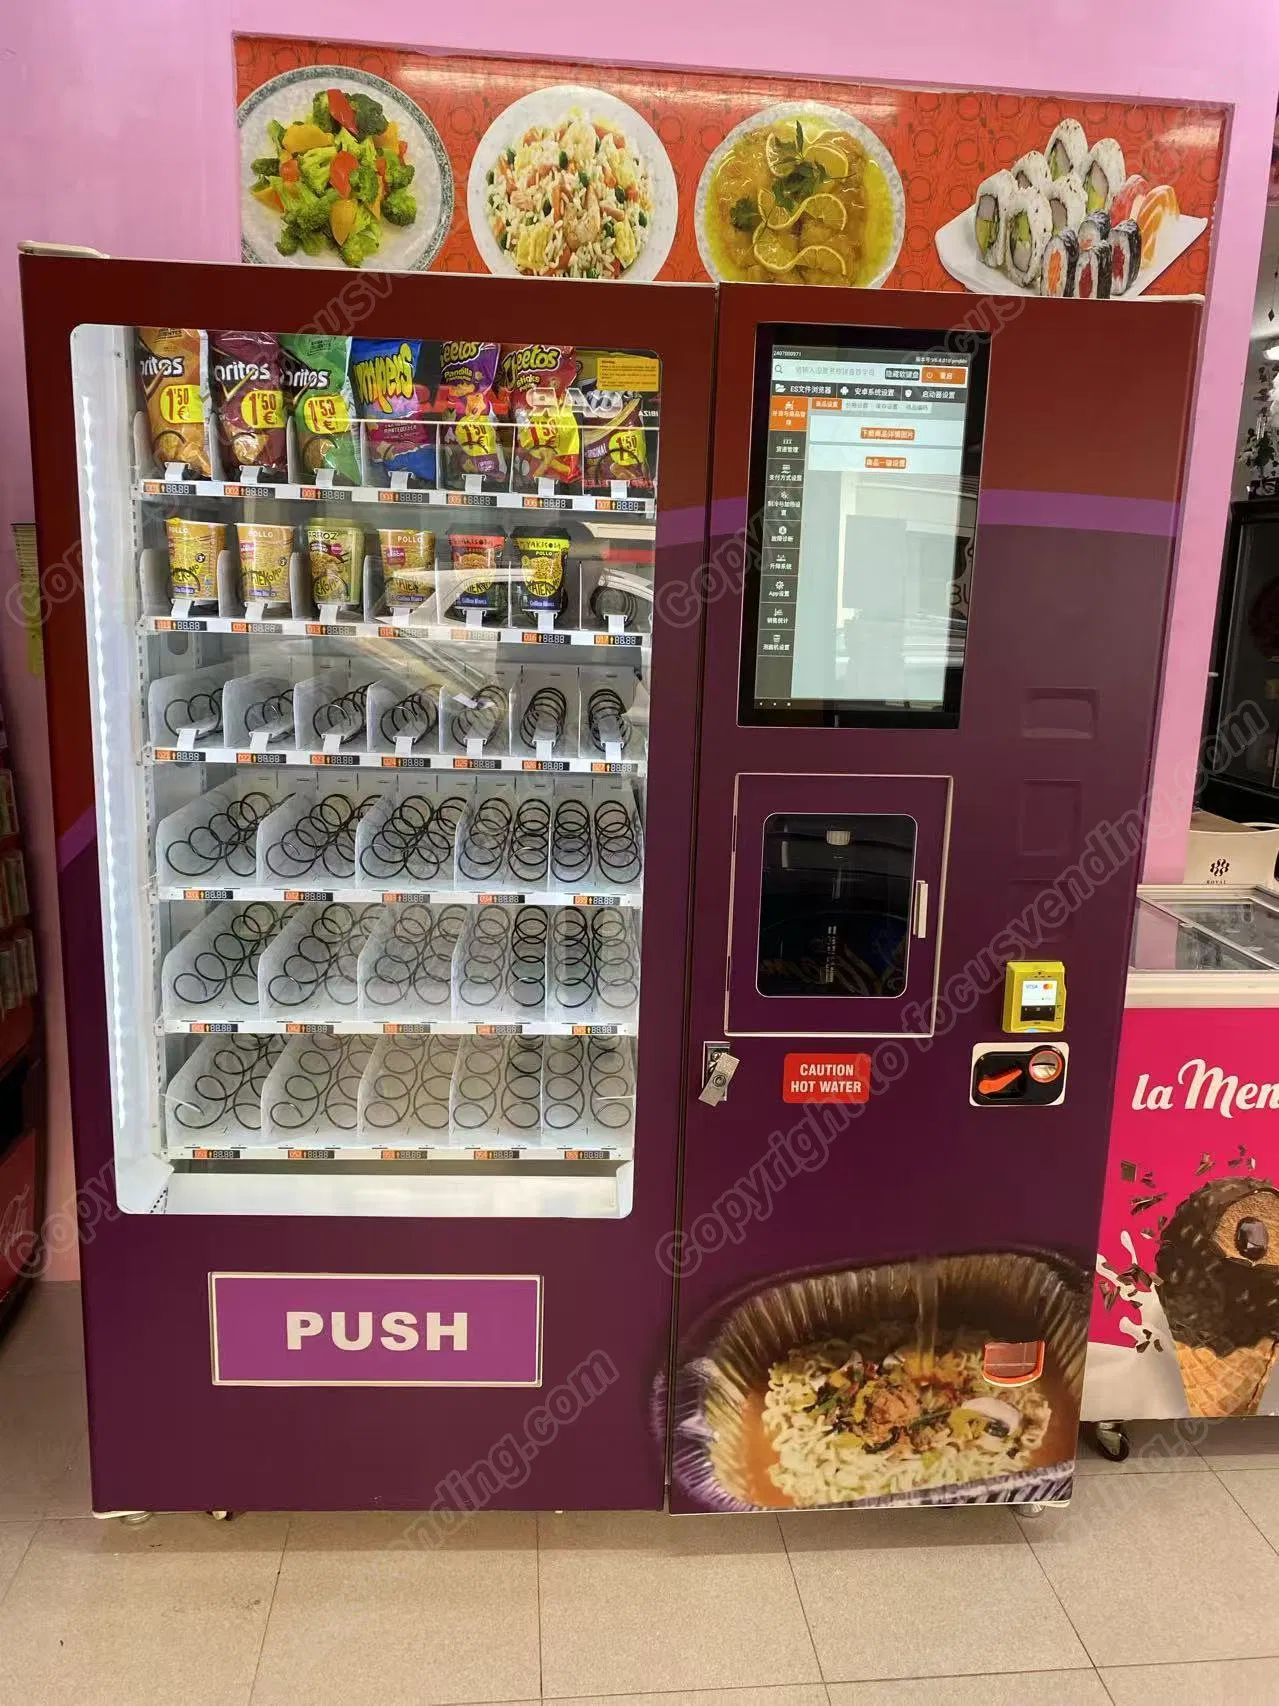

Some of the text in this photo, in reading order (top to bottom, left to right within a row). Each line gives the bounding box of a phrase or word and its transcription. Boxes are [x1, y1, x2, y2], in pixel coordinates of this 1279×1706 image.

[800, 1064, 854, 1076] CAUTION
[790, 1081, 862, 1093] HOT WATER
[1132, 1073, 1174, 1111] la
[286, 1311, 468, 1351] PUSH
